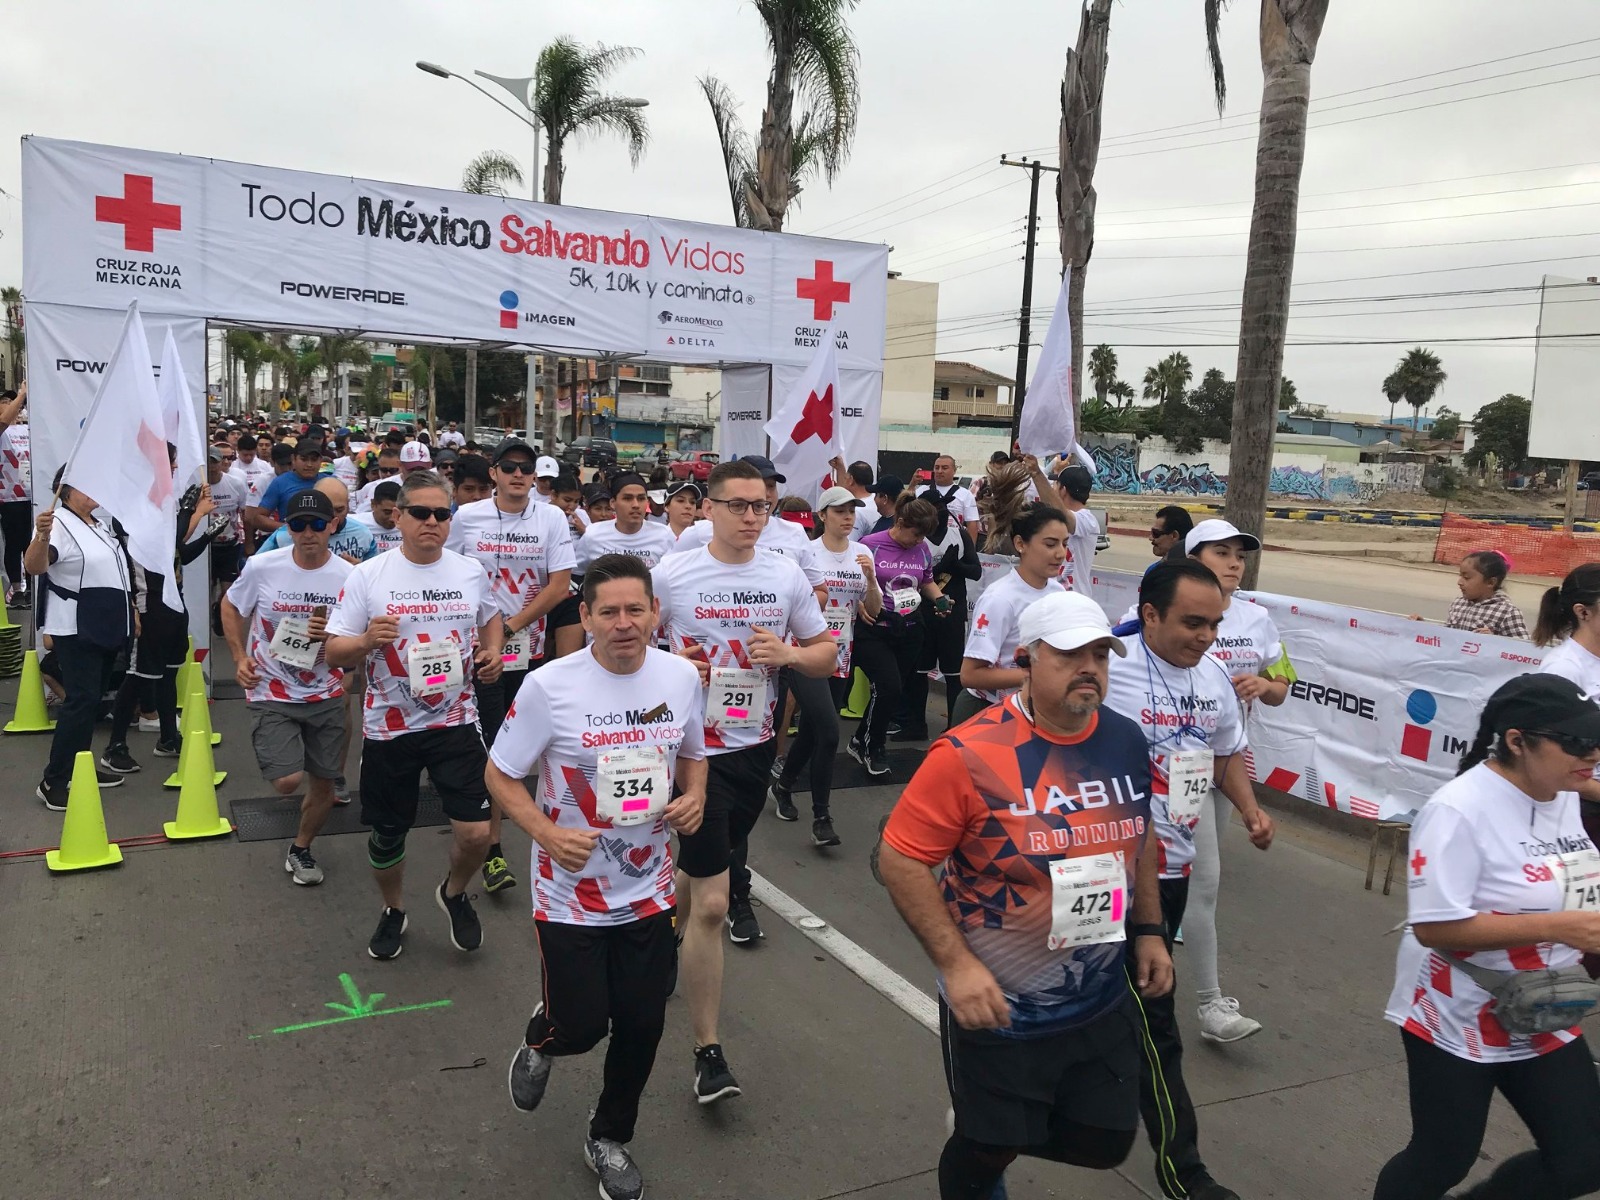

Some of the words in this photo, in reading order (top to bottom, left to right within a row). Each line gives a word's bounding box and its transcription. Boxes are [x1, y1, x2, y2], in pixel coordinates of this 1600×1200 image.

[241, 183, 345, 228] Todo
[357, 196, 491, 250] México
[500, 214, 650, 268] Salvando
[660, 236, 745, 275] Vidas
[95, 257, 138, 273] CRUZ
[141, 261, 182, 277] ROJA
[95, 271, 182, 290] MEXICANA
[605, 270, 641, 294] 10k
[646, 280, 658, 299] y
[280, 281, 406, 306] POWERADE
[525, 312, 575, 327] IMAGEN
[795, 326, 821, 338] CRUZ
[678, 336, 715, 347] DELTA
[794, 337, 849, 350] MEXINA
[481, 530, 505, 540] Todo
[506, 532, 539, 543] México
[477, 541, 517, 553] Salvando
[878, 560, 898, 568] CLUB
[837, 570, 862, 580] México
[825, 579, 847, 588] vando
[277, 590, 302, 600] Todo
[303, 592, 337, 605] México
[389, 589, 420, 601] Todo
[422, 588, 463, 602] México
[697, 591, 731, 603] Todo
[733, 590, 777, 605] México
[272, 601, 315, 614] Salvando
[386, 602, 438, 616] Salvando
[440, 602, 471, 612] Vidas
[900, 598, 916, 609] 356
[694, 605, 750, 619] Salvando
[751, 605, 784, 617] Vidas
[733, 620, 747, 628] 10k
[826, 621, 845, 631] 287
[282, 636, 310, 652] 464
[1215, 635, 1253, 648] México
[500, 644, 521, 655] 85
[1508, 653, 1531, 664] SPORT
[422, 660, 452, 677] 283
[722, 692, 753, 706] 291
[1144, 691, 1177, 707] Todo
[1290, 679, 1378, 721] ERADE
[584, 711, 623, 728] Todo
[1140, 708, 1196, 728] Salvando
[581, 727, 646, 748] Salvando
[613, 777, 654, 798] 334
[1184, 777, 1208, 797] 742
[1008, 774, 1145, 817] JABIL
[1028, 816, 1146, 852] RUNNING
[1070, 891, 1111, 916] 472
[1077, 916, 1102, 927] JESUS
